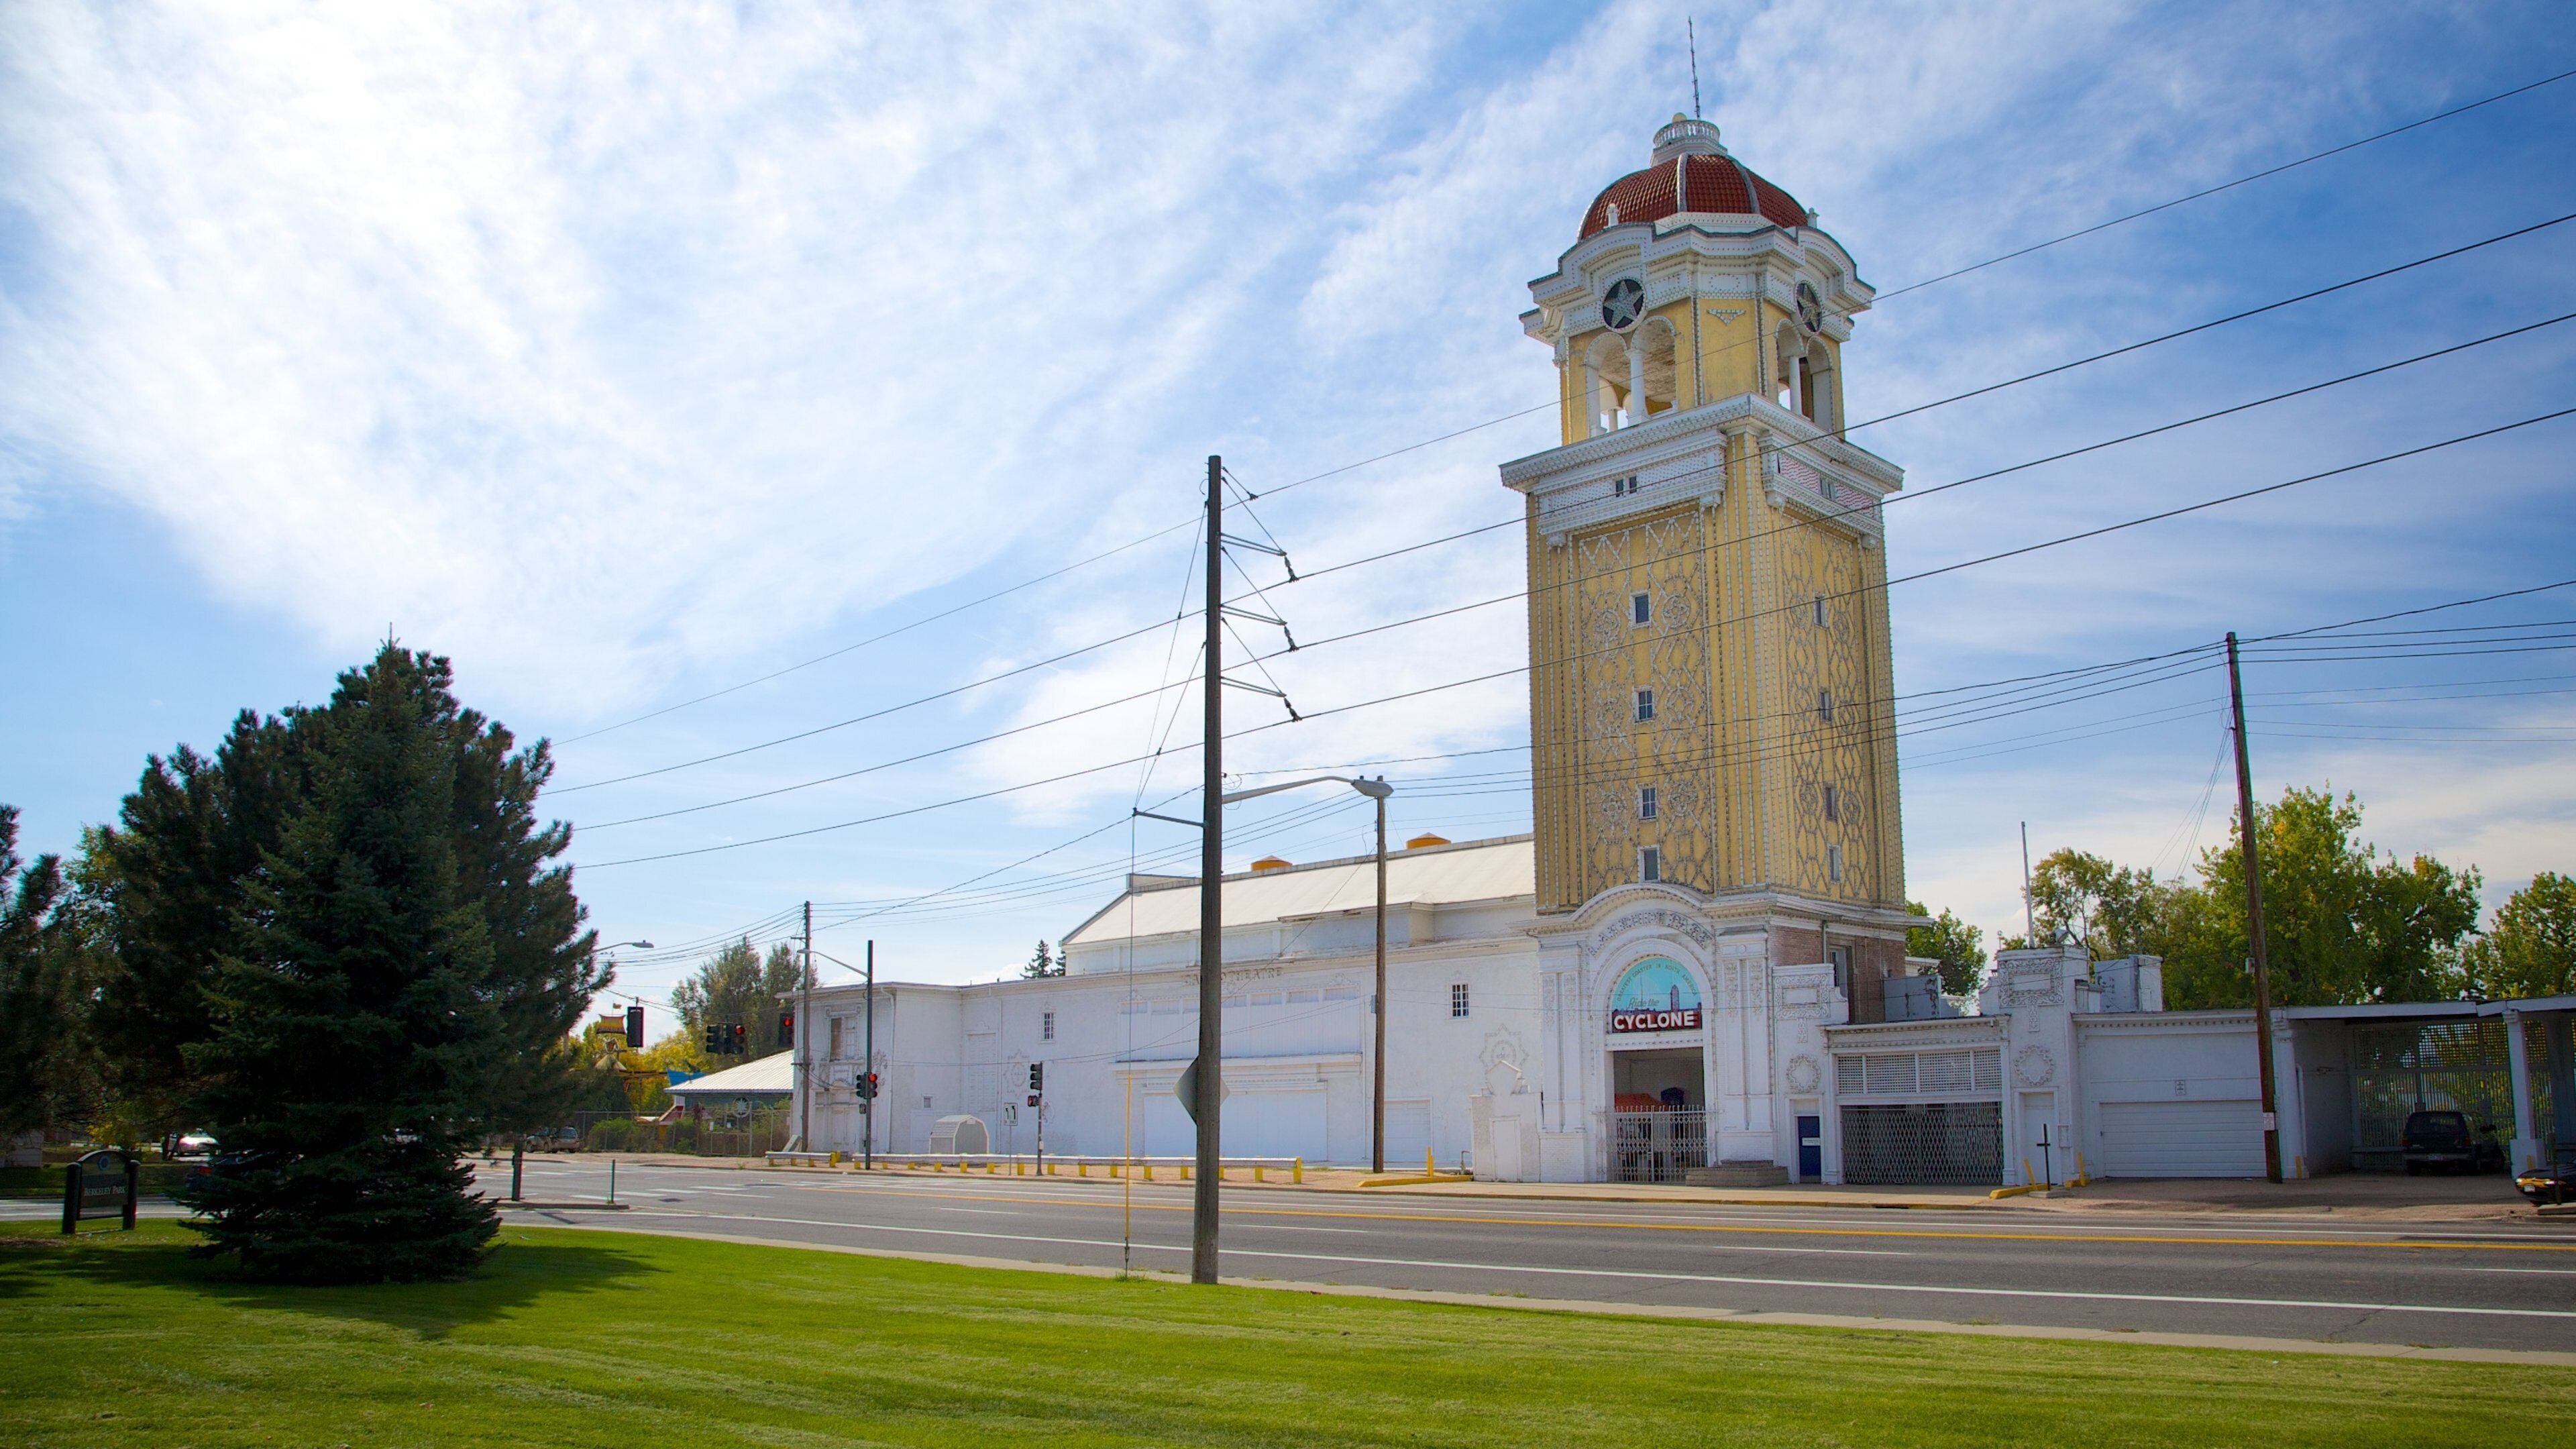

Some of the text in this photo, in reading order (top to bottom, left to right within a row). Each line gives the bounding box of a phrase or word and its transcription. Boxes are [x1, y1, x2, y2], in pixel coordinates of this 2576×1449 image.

[1631, 964, 1652, 977] COASTER
[1682, 974, 1697, 996] AMERICA
[1626, 997, 1660, 1009] Ride the
[1613, 1010, 1695, 1030] CYCLONE
